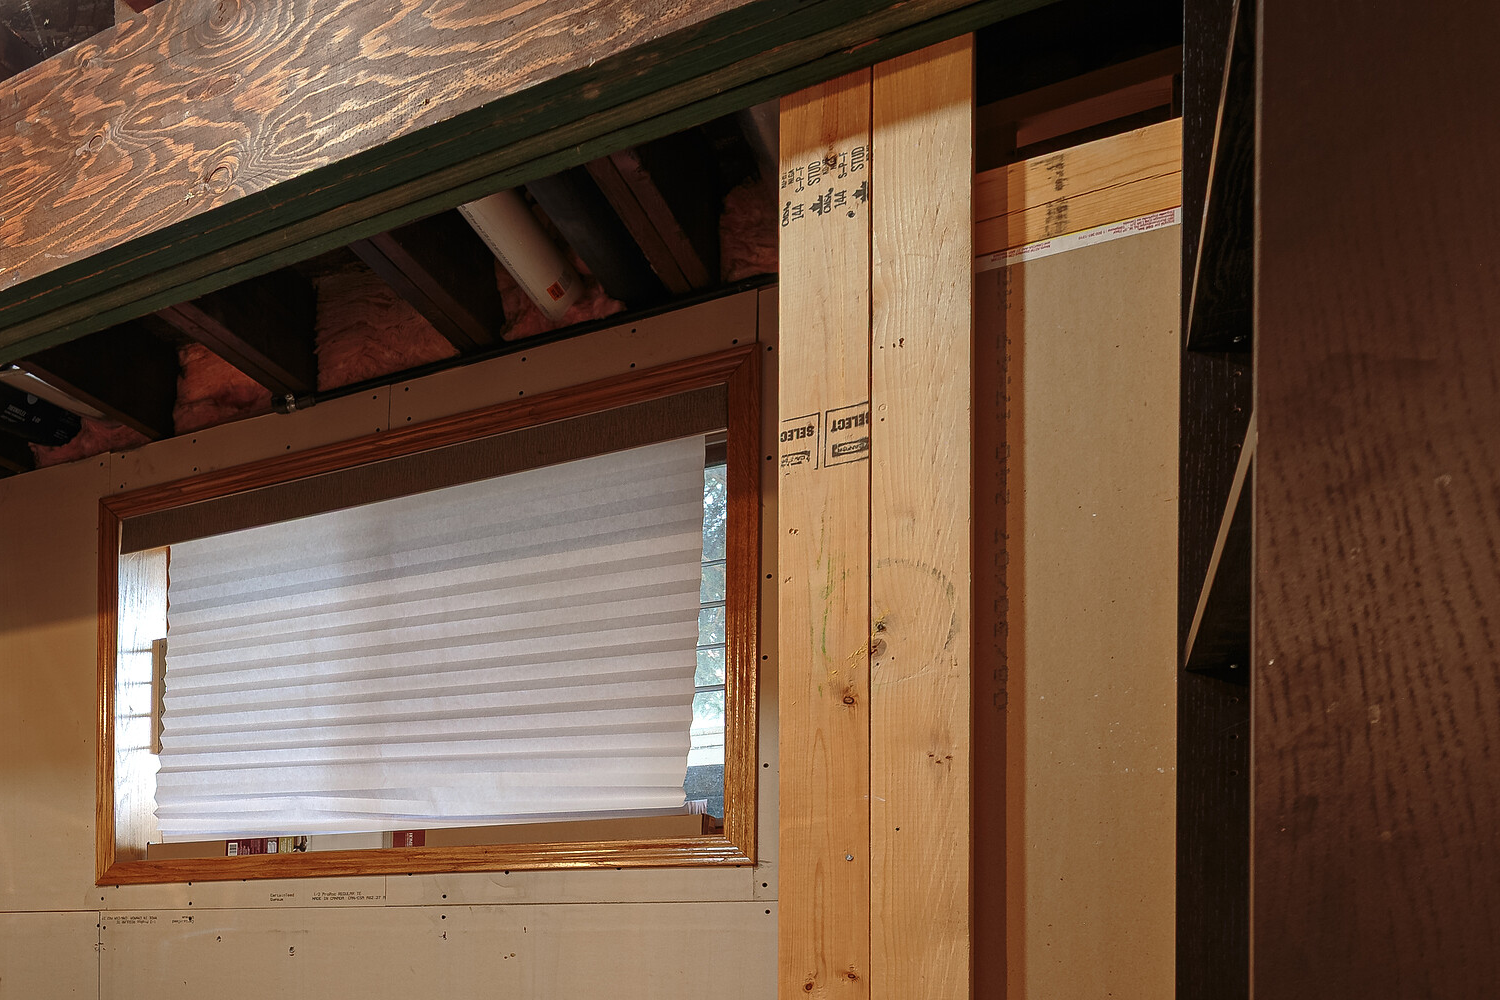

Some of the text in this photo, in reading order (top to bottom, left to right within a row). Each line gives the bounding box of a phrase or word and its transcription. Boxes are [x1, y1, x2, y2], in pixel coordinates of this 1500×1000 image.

[838, 152, 848, 180] S-P-F
[850, 146, 865, 172] STUD
[794, 166, 805, 193] S-P-F
[808, 160, 821, 186] STUD
[792, 203, 804, 222] 144
[834, 190, 847, 209] 144
